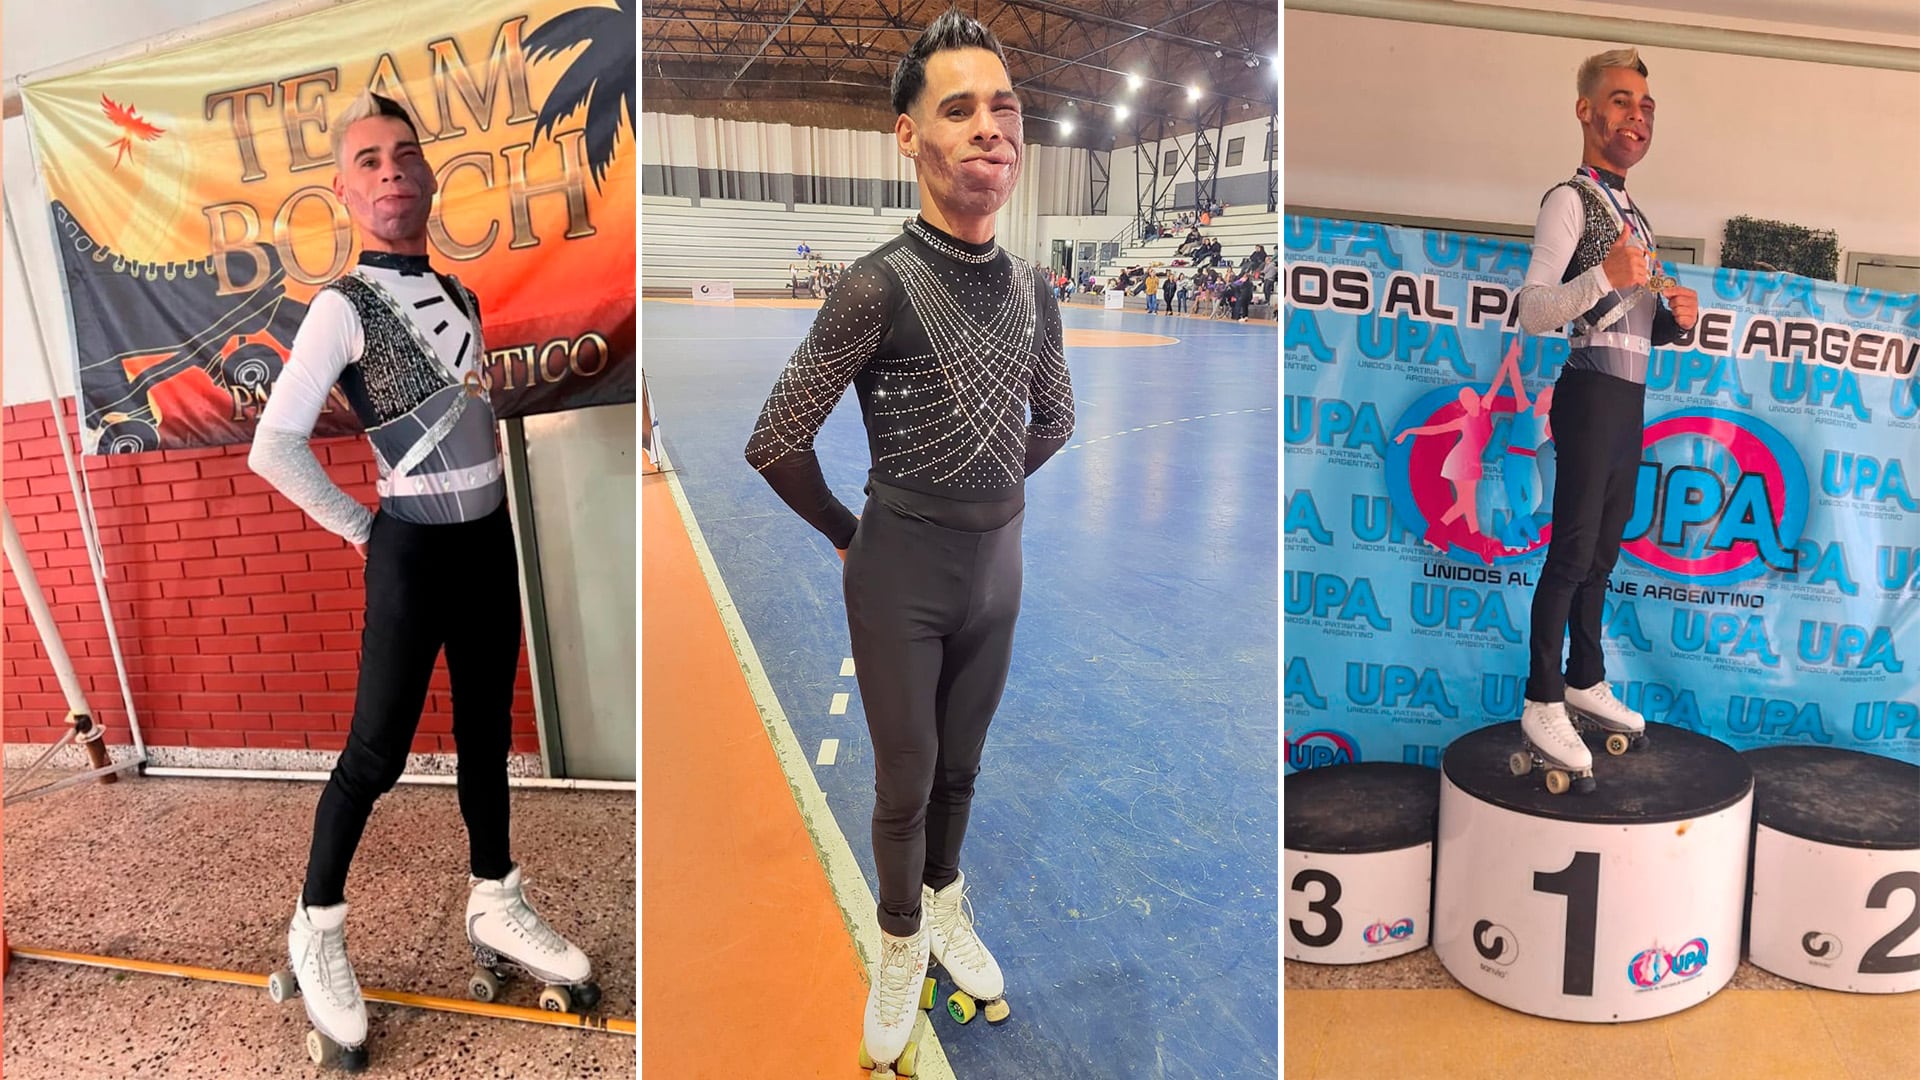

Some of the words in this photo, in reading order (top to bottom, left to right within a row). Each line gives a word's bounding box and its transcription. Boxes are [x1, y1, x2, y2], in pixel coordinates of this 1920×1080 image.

[206, 15, 538, 183] TEAM
[203, 128, 597, 297] BOCH
[1284, 264, 1369, 310] OS
[1385, 275, 1453, 320] AL
[1742, 319, 1920, 375] ARGEN
[1357, 308, 1477, 379] UPA
[1769, 355, 1872, 424] UPA
[1284, 394, 1390, 460] UPA
[1820, 449, 1920, 513] UPA
[1284, 570, 1392, 632] UPA
[1410, 582, 1523, 645] UPA
[1423, 563, 1502, 585] UNIDOS
[1507, 571, 1534, 587] AL
[1643, 585, 1765, 610] ARGENTINO
[1670, 607, 1781, 670] UPA
[1797, 619, 1905, 674] UPA
[1346, 661, 1460, 719] UPA
[1727, 695, 1834, 745] UPA
[1289, 869, 1343, 948] 3
[1533, 850, 1600, 997] 1
[1857, 870, 1920, 975] 2
